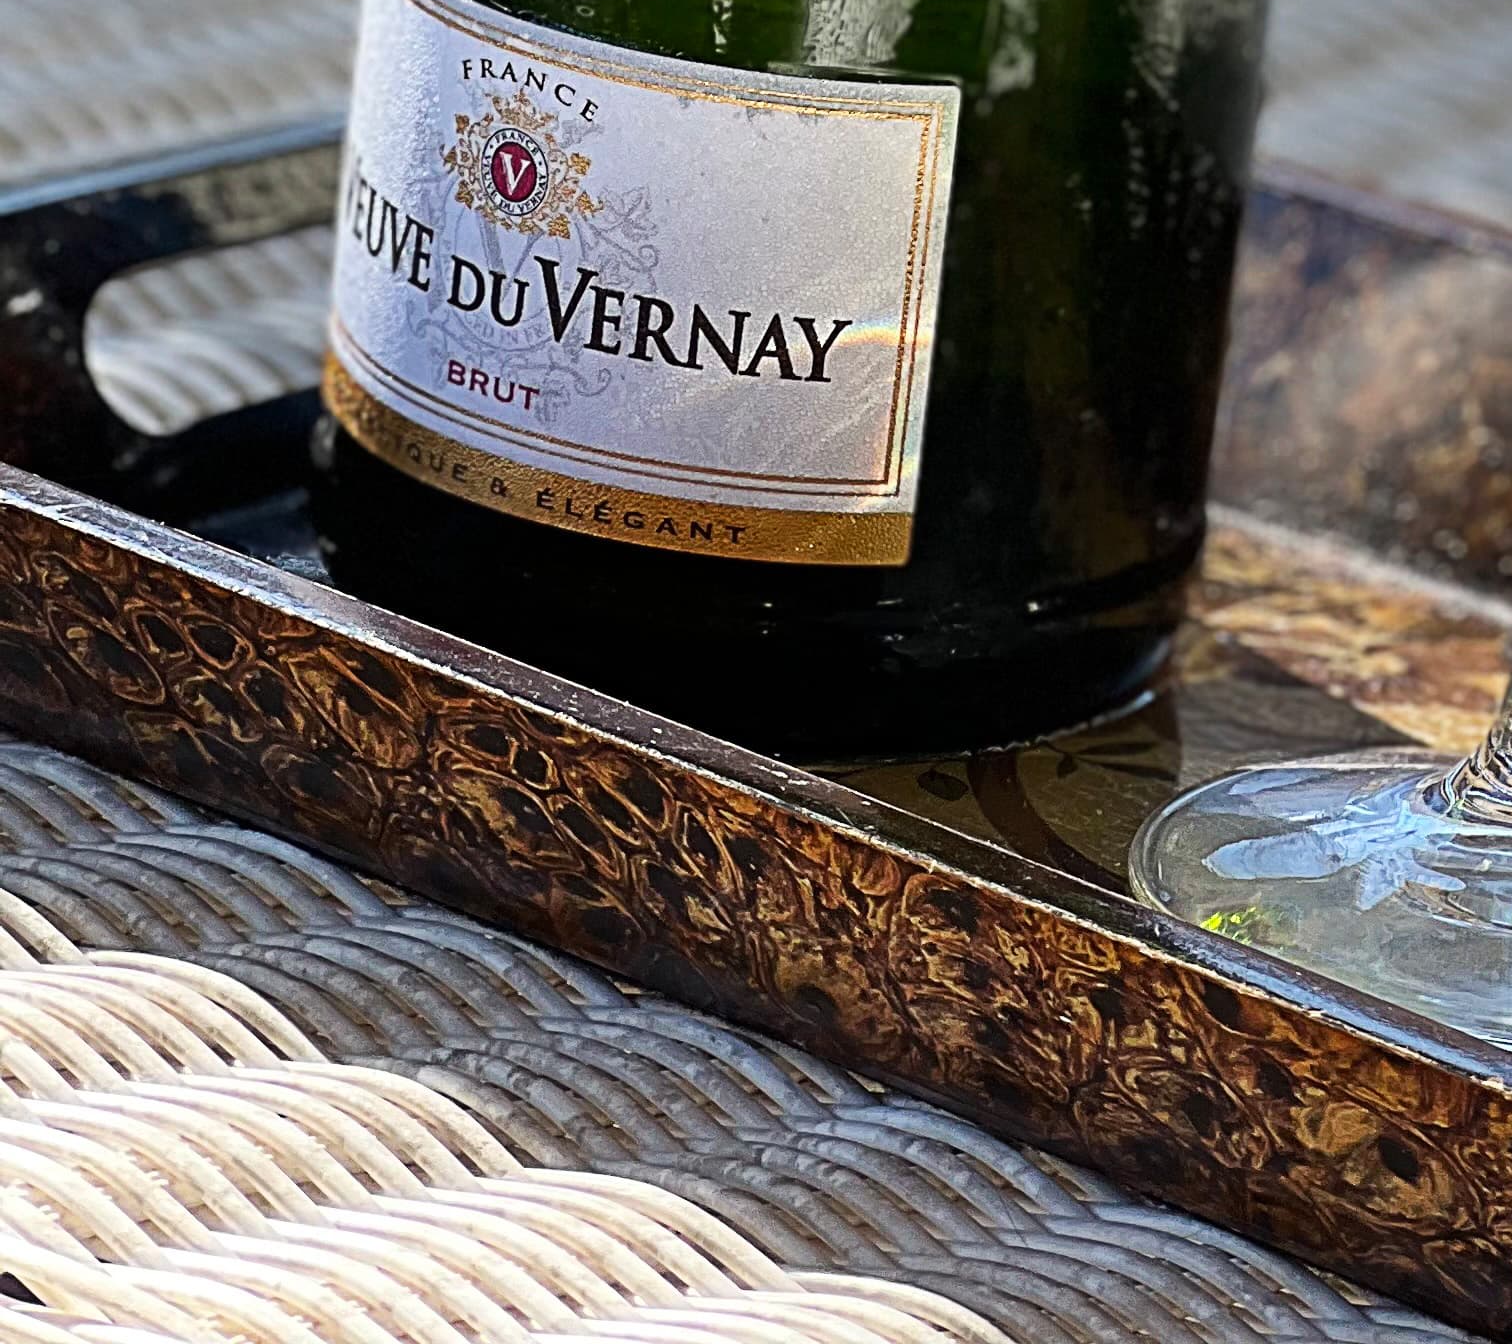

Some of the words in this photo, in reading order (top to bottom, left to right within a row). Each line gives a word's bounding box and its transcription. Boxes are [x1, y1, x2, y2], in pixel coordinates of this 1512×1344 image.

[462, 58, 599, 122] FRANCE
[494, 132, 539, 156] FRANCE
[499, 151, 531, 196] V
[447, 254, 530, 327] DU
[533, 255, 853, 383] VERNAY
[447, 360, 541, 411] BRUT
[490, 476, 516, 497] &
[537, 487, 747, 544] ÉLÉGANT
